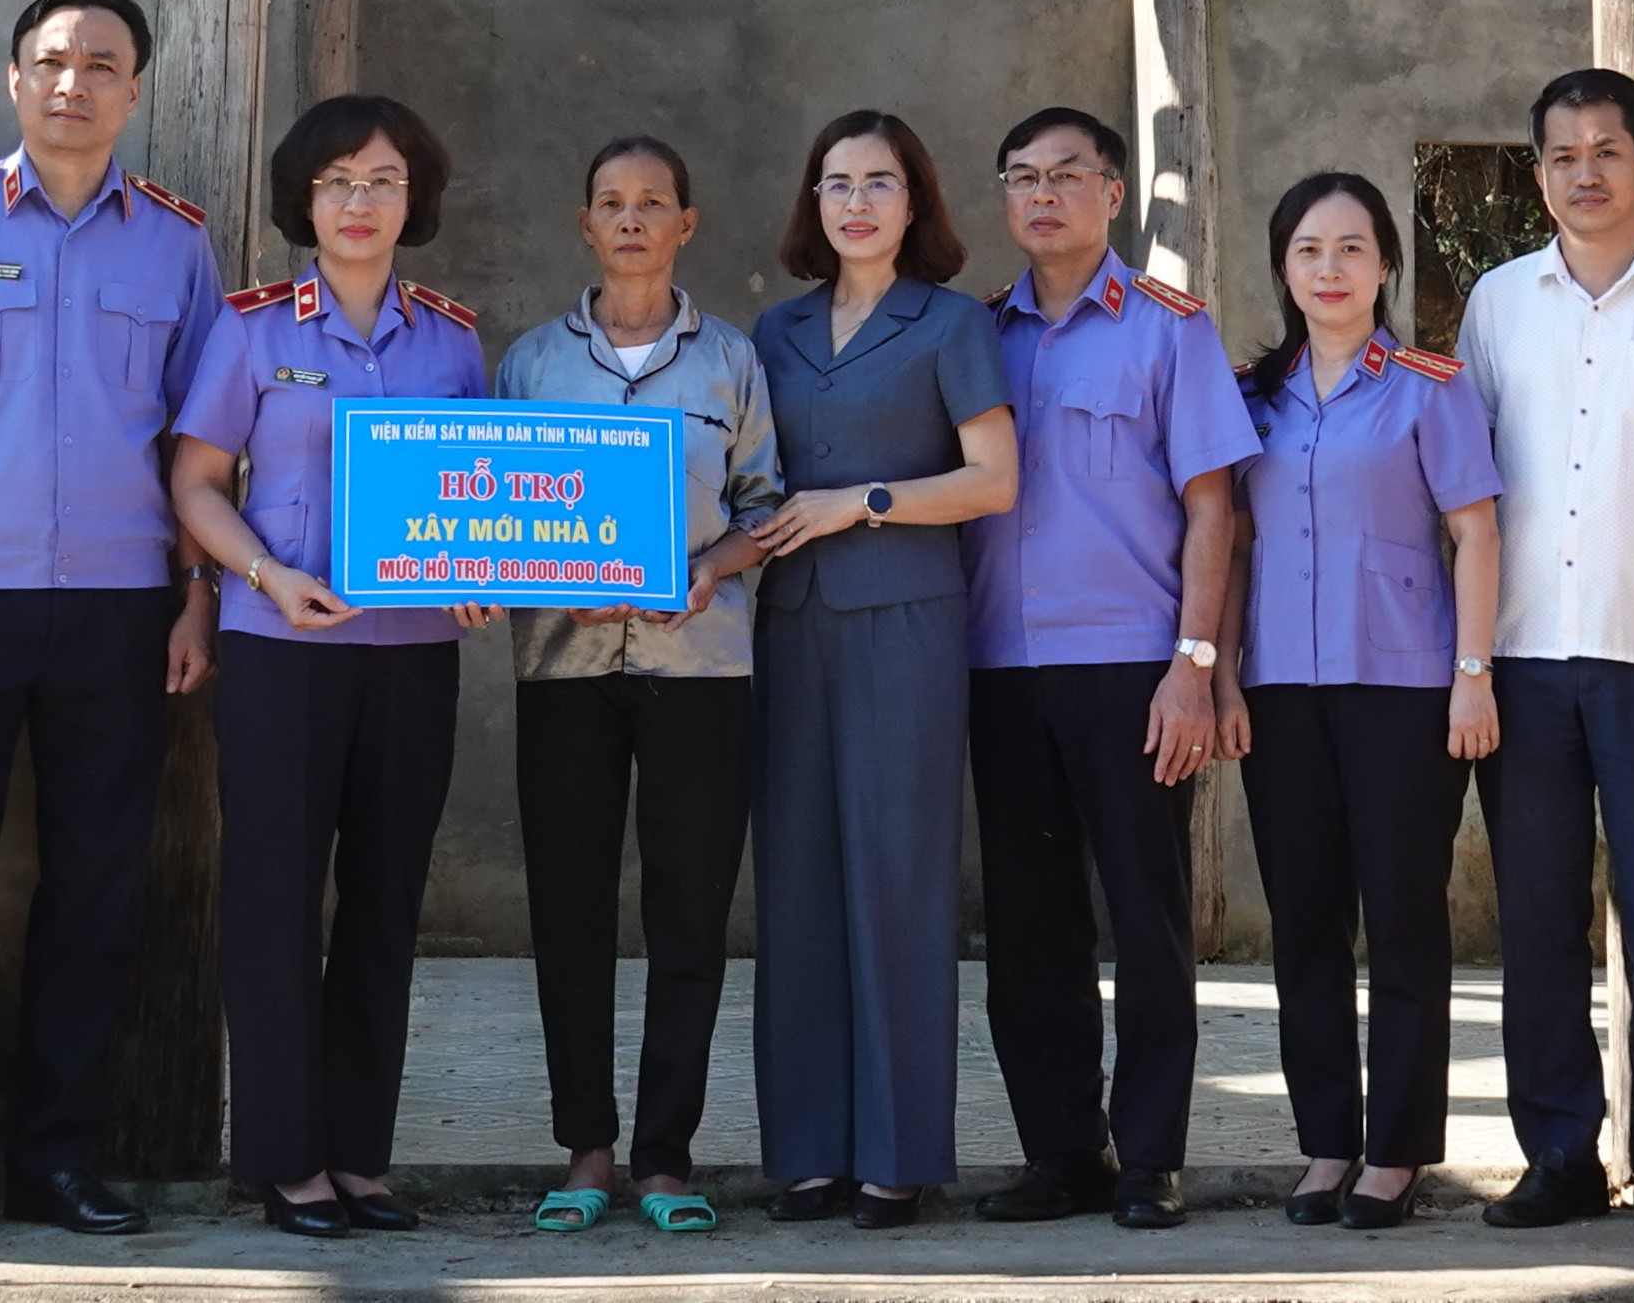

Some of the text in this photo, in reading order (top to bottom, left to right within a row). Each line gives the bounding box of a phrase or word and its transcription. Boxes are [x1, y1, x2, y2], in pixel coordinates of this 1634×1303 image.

[370, 420, 400, 444] VIỆN
[404, 417, 436, 441] KIỂM
[440, 421, 464, 441] SÁT
[468, 421, 503, 442] NHÂN
[507, 422, 532, 443] DÂN
[569, 425, 598, 445] THÁI
[601, 427, 650, 448] NGUYÊN
[439, 458, 585, 510] HỖ TRỢ
[406, 513, 617, 545] XÂY MỚI NHÀ Ở
[377, 553, 420, 582] MỨC
[424, 550, 450, 581] HỖ
[454, 556, 495, 586] TRỢ:
[499, 558, 596, 584] 80.000.000
